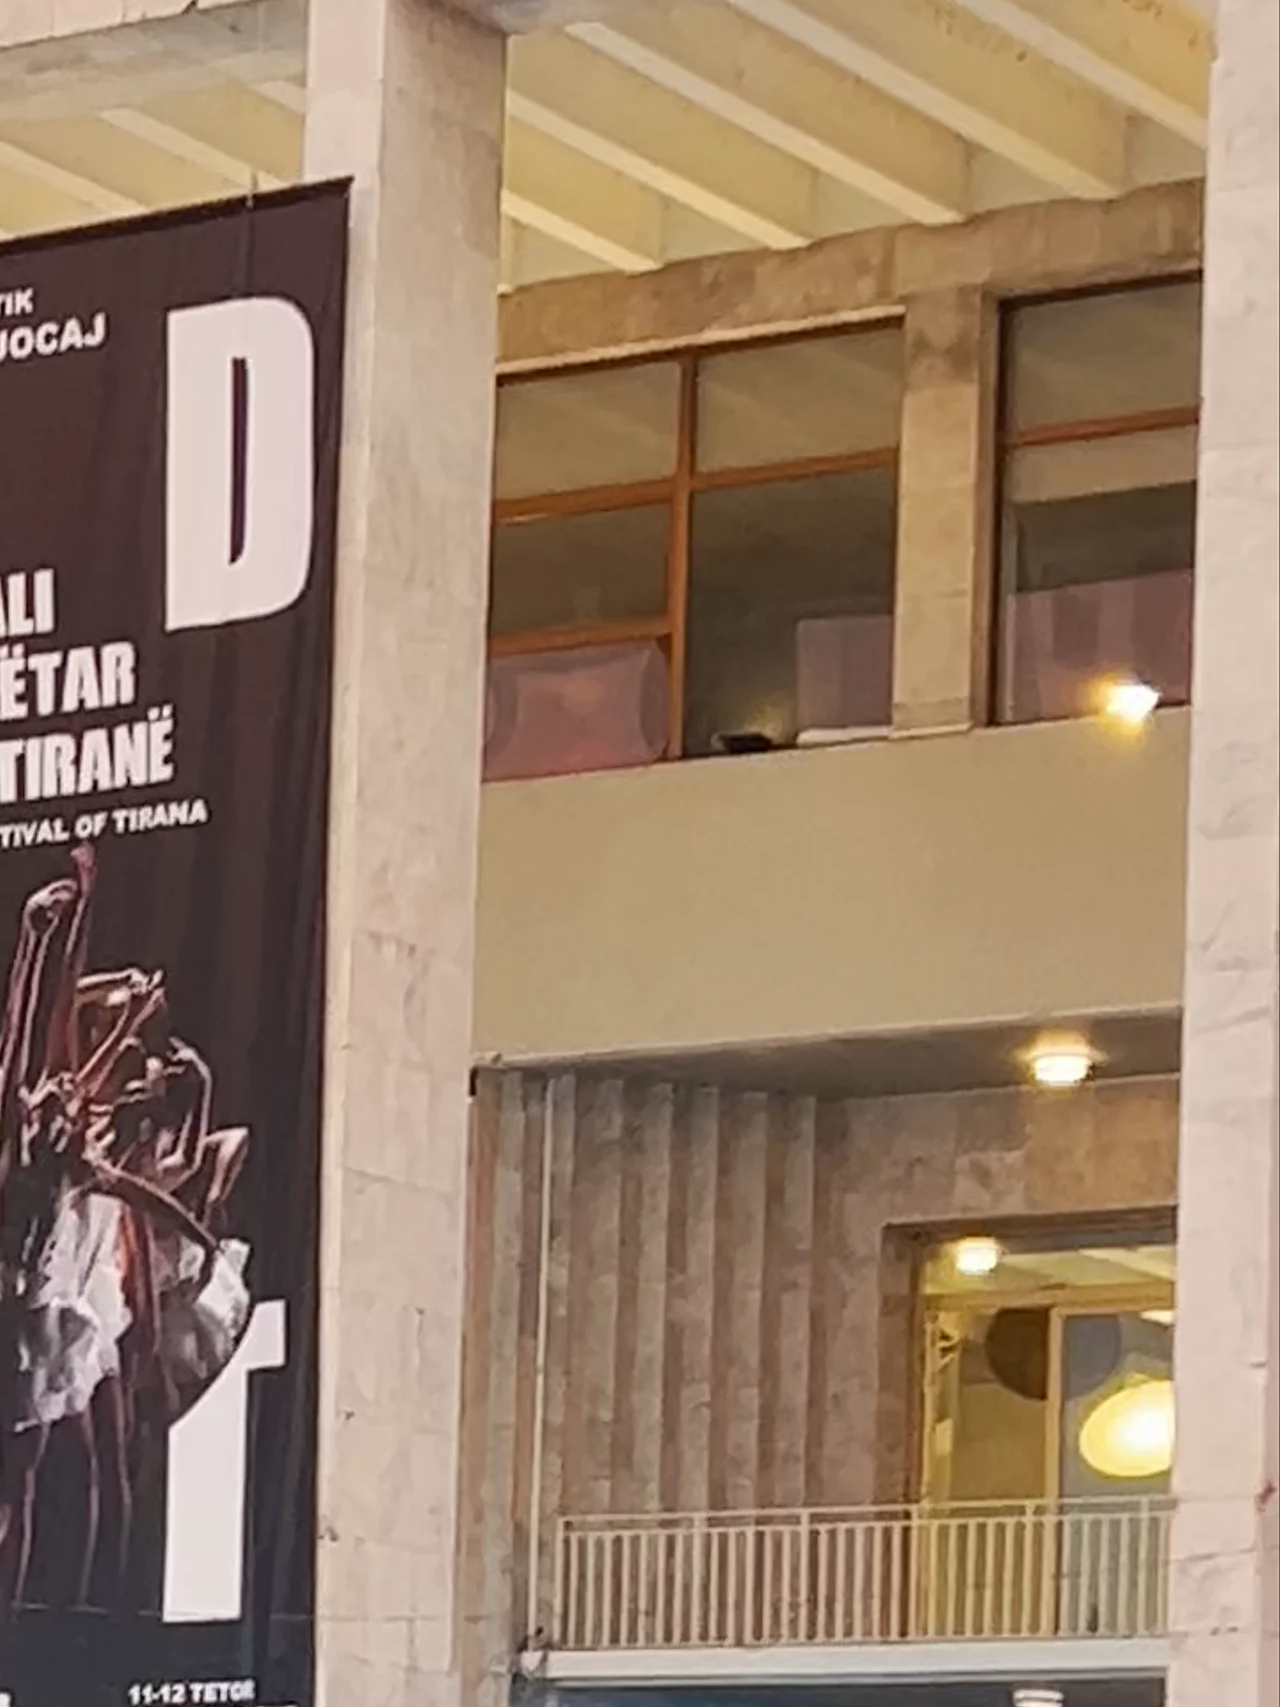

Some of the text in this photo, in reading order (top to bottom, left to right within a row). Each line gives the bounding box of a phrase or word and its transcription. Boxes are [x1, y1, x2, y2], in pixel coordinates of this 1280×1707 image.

[166, 296, 315, 632] D
[75, 811, 109, 838] OF
[112, 798, 209, 834] TIRANA
[127, 1678, 256, 1706] 11-12 TETOR
